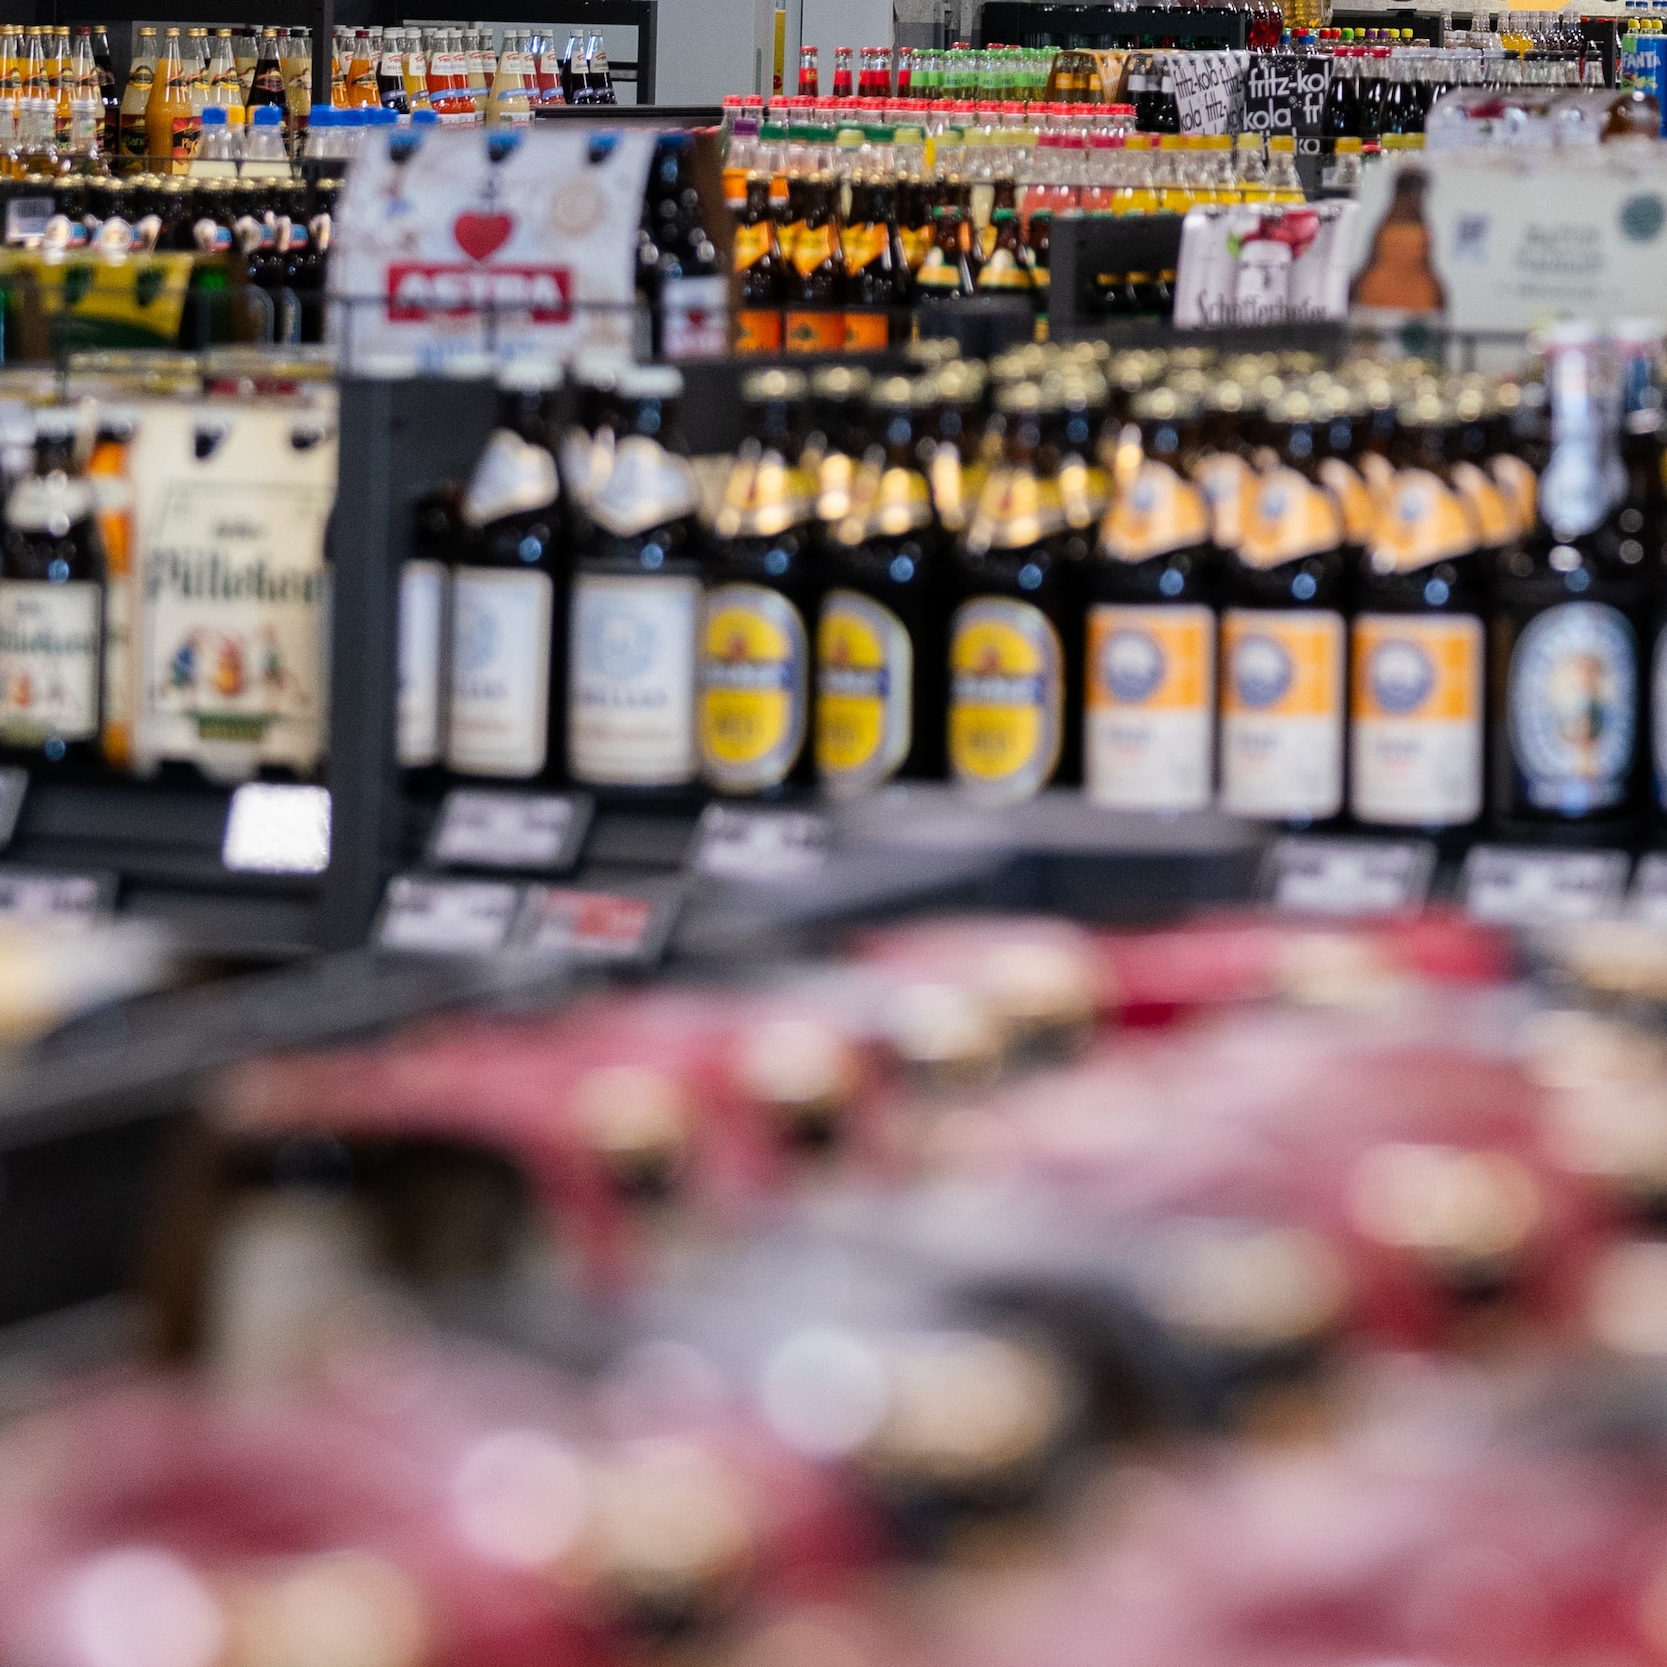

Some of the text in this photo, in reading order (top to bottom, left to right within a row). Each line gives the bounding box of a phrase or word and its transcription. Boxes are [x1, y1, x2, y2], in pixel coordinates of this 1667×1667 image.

[1249, 62, 1331, 99] fritz-kol
[1243, 98, 1292, 131] kola
[396, 272, 563, 314] ASTRA
